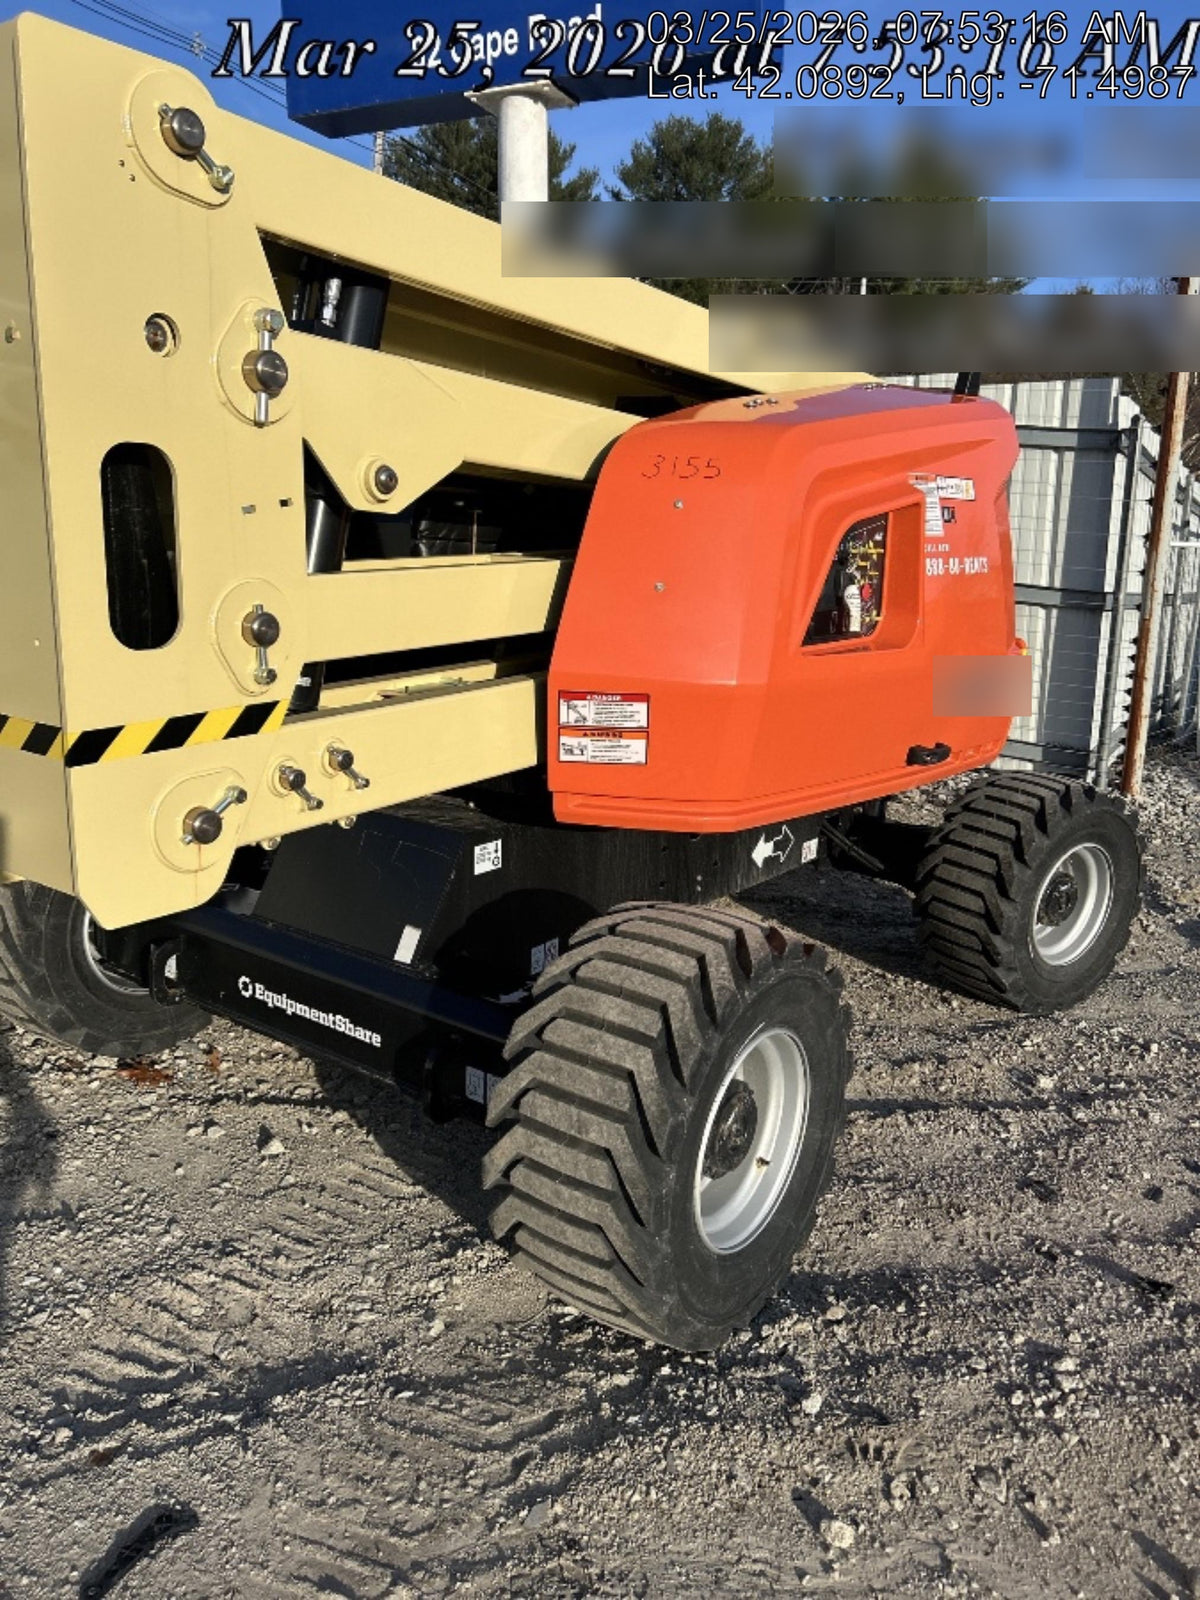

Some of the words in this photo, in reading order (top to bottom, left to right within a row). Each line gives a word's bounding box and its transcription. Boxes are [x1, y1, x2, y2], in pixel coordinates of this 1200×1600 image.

[449, 27, 520, 67] Cape
[527, 3, 603, 52] Road
[641, 454, 722, 479] 3155
[254, 982, 382, 1048] EquipmentShare
